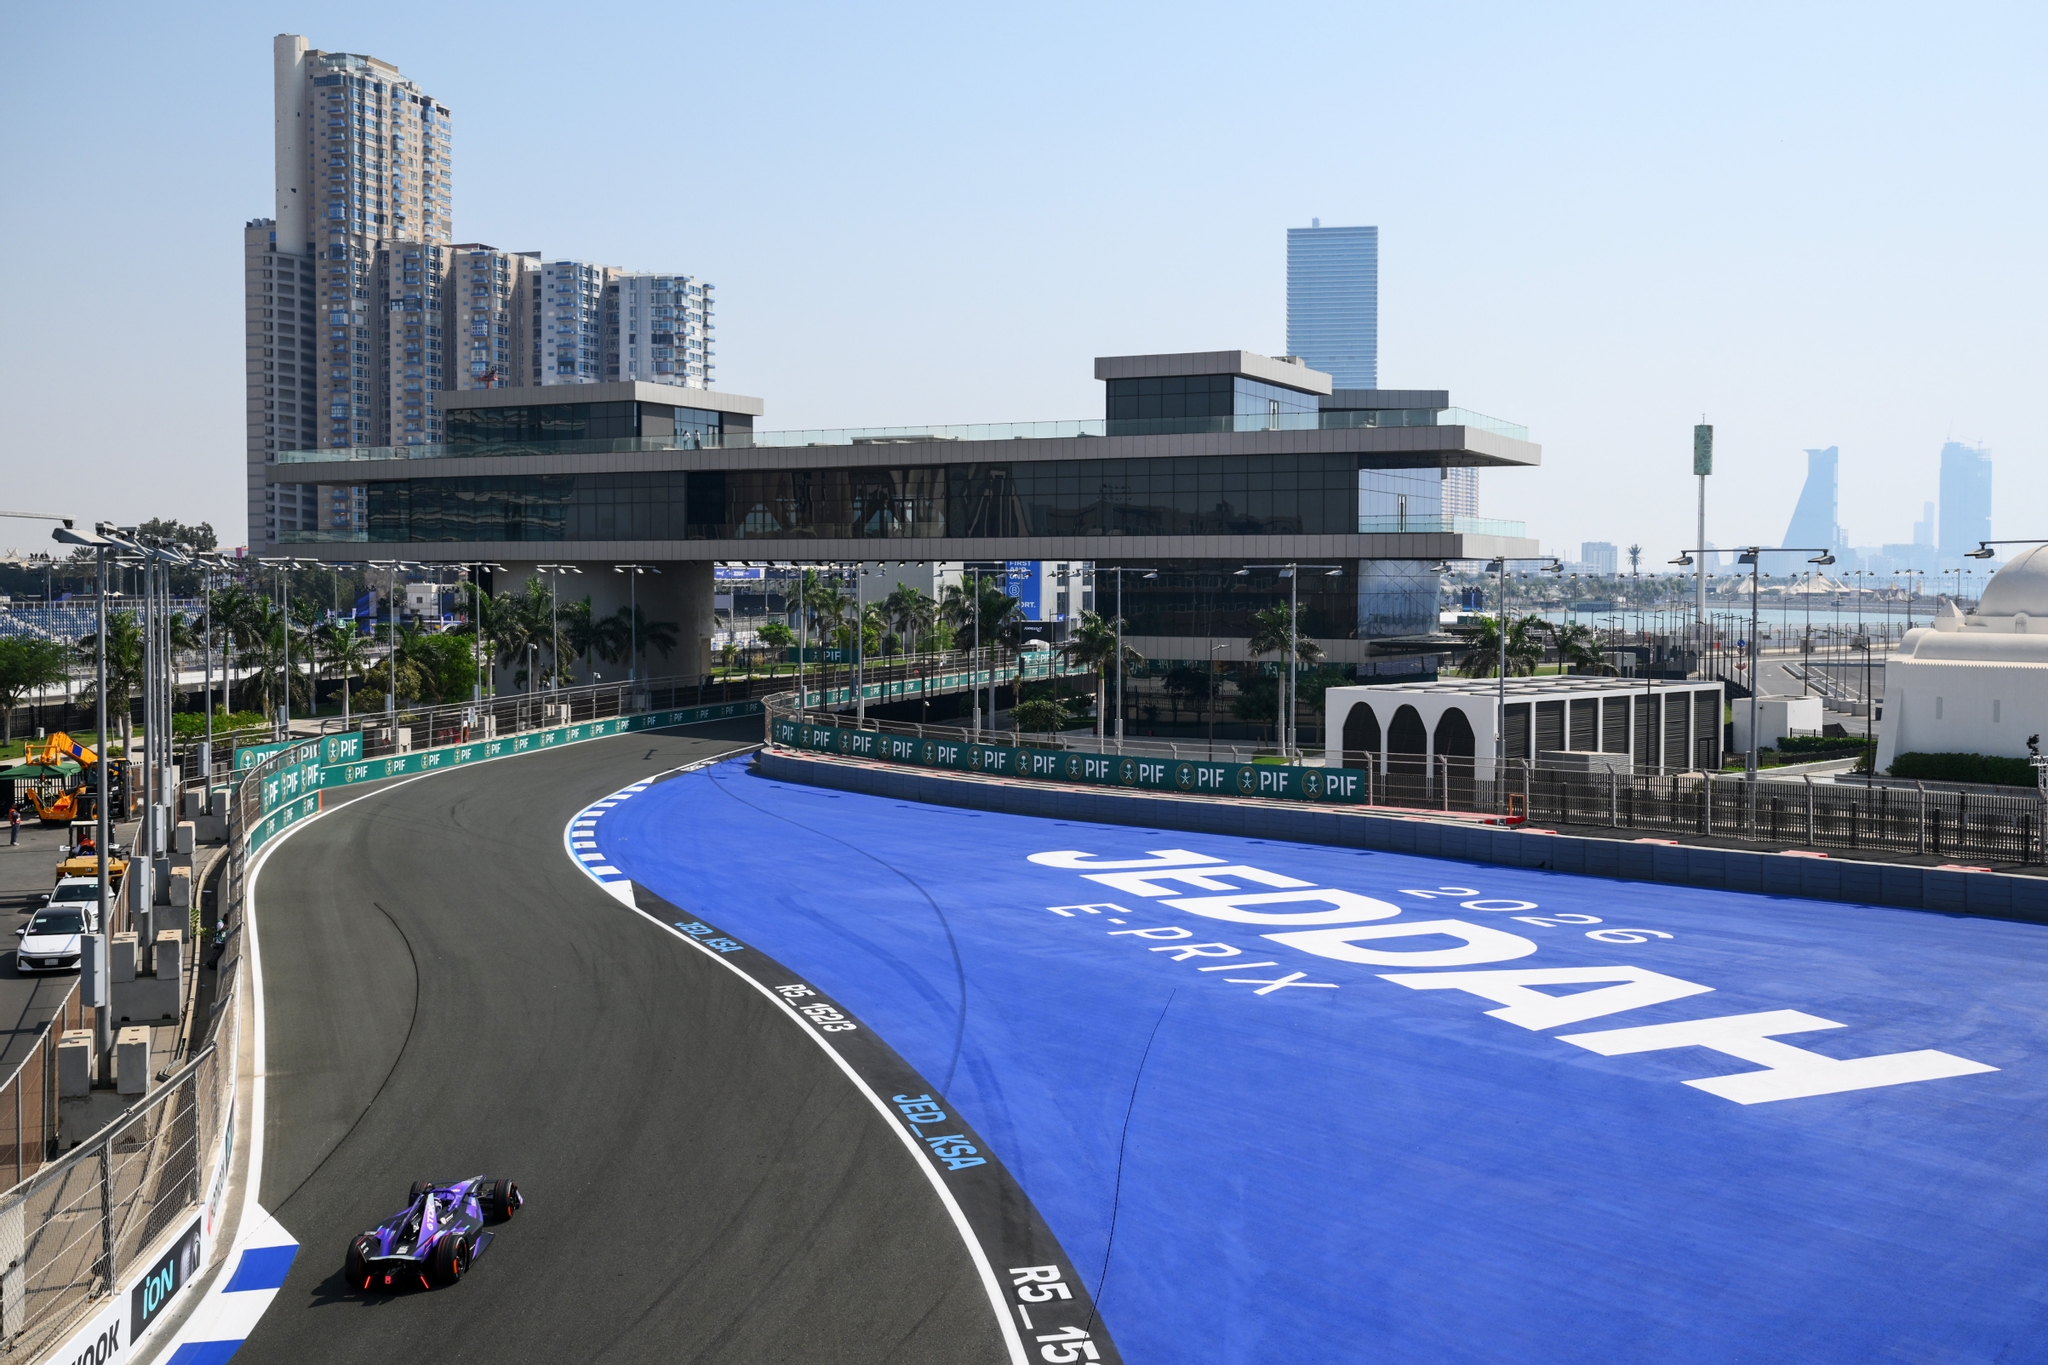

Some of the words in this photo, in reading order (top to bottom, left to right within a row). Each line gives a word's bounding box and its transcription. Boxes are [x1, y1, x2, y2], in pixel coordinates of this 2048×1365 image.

[700, 709, 709, 718] PIF
[726, 706, 734, 714] PIF
[750, 703, 758, 711] PIF
[621, 720, 630, 730] PIF
[647, 716, 656, 726] PIF
[674, 712, 683, 722] PIF
[571, 728, 580, 738] PIF
[596, 724, 604, 734] PIF
[782, 724, 794, 742] PIF
[520, 738, 529, 749] PIF
[546, 733, 555, 744] PIF
[814, 730, 830, 747] PIF
[853, 735, 872, 752] PIF
[341, 738, 358, 758] PIF
[461, 748, 472, 760] PIF
[491, 743, 501, 754] PIF
[893, 740, 913, 758] PIF
[938, 746, 958, 764] PIF
[394, 759, 406, 772] PIF
[429, 754, 440, 766] PIF
[984, 750, 1006, 769] PIF
[1033, 755, 1056, 774] PIF
[308, 764, 318, 786] PIF
[355, 766, 368, 778] PIF
[1085, 760, 1109, 778] PIF
[1139, 764, 1165, 784] PIF
[1198, 768, 1225, 788] PIF
[286, 772, 298, 794] PIF
[1260, 771, 1289, 792] PIF
[1326, 775, 1357, 796] PIF
[270, 780, 278, 806] PIF
[1398, 887, 1674, 944] 2026
[674, 921, 744, 952] JED_KSA
[1046, 903, 1340, 996] E-PRIX
[1026, 848, 2000, 1105] JEDDAH
[774, 984, 857, 1032] R5_152/3
[892, 1094, 987, 1171] JED_KSA
[144, 1259, 174, 1320] iON
[1009, 1265, 1101, 1365] R5_15
